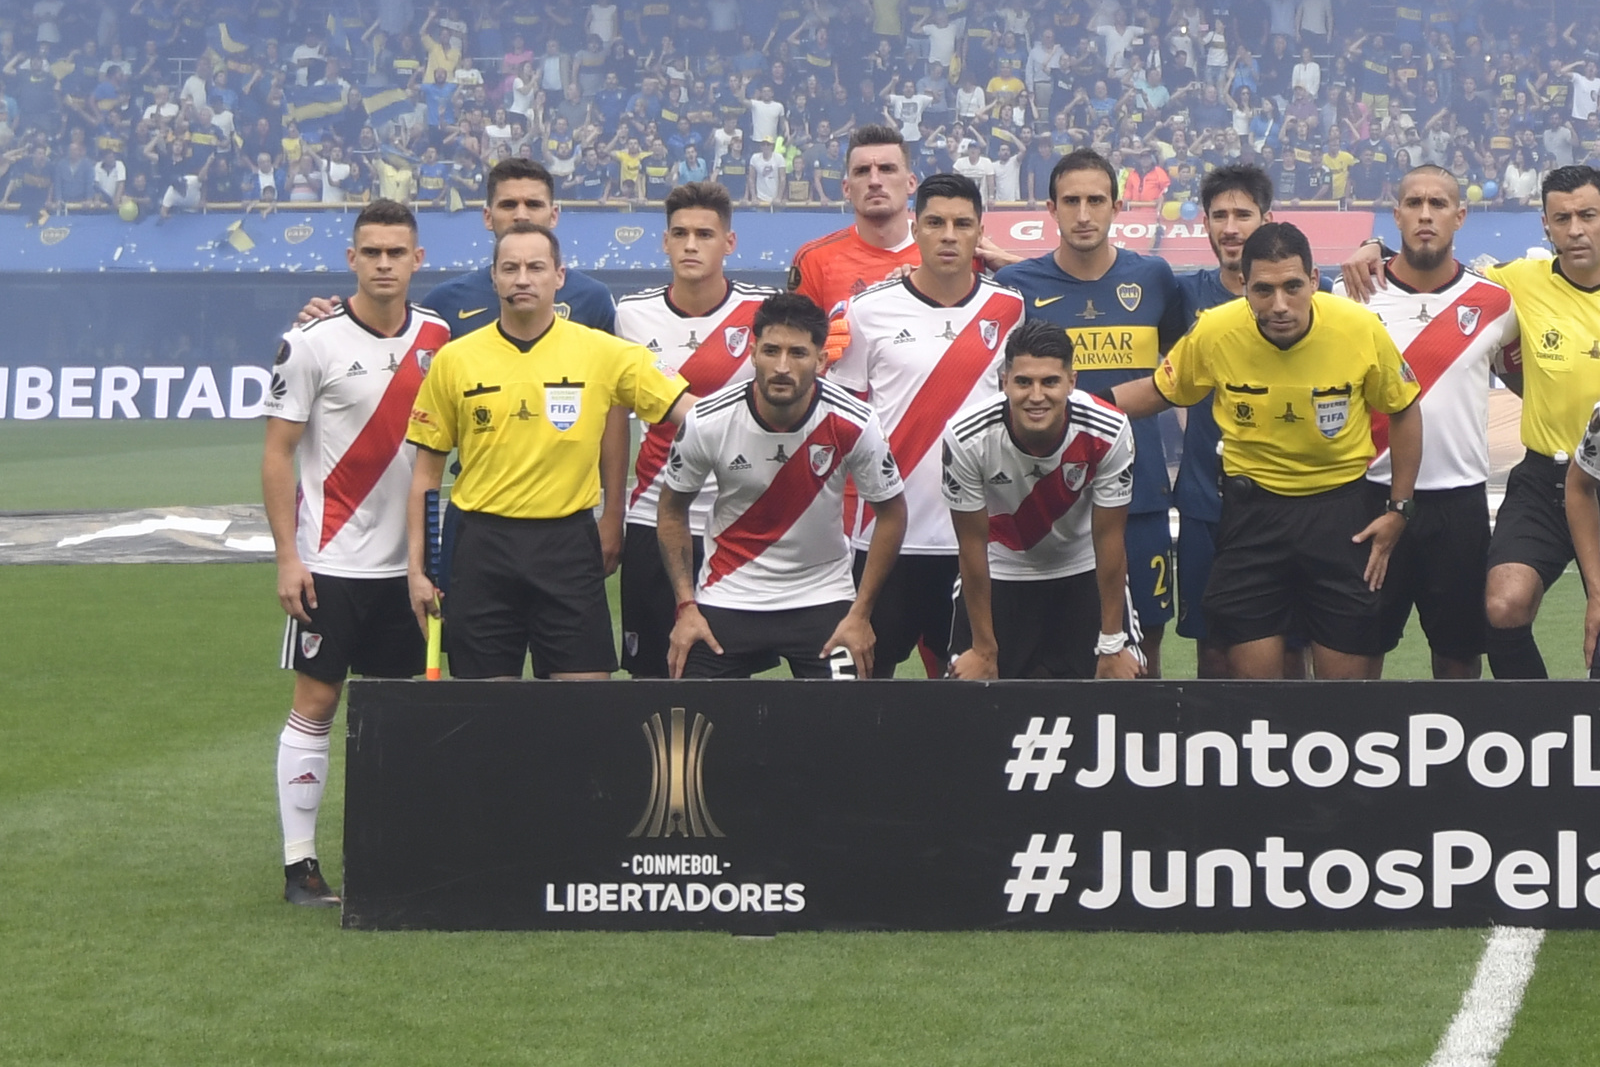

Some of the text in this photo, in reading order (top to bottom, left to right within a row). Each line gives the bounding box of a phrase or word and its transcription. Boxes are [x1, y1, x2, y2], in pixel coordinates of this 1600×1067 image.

[1074, 332, 1133, 351] ATAR
[1073, 352, 1133, 365] AIRWAYS
[550, 404, 577, 414] FIFA
[1317, 401, 1348, 409] REFEREE
[1319, 412, 1345, 423] FIFA
[546, 882, 806, 913] LIBERTADORES
